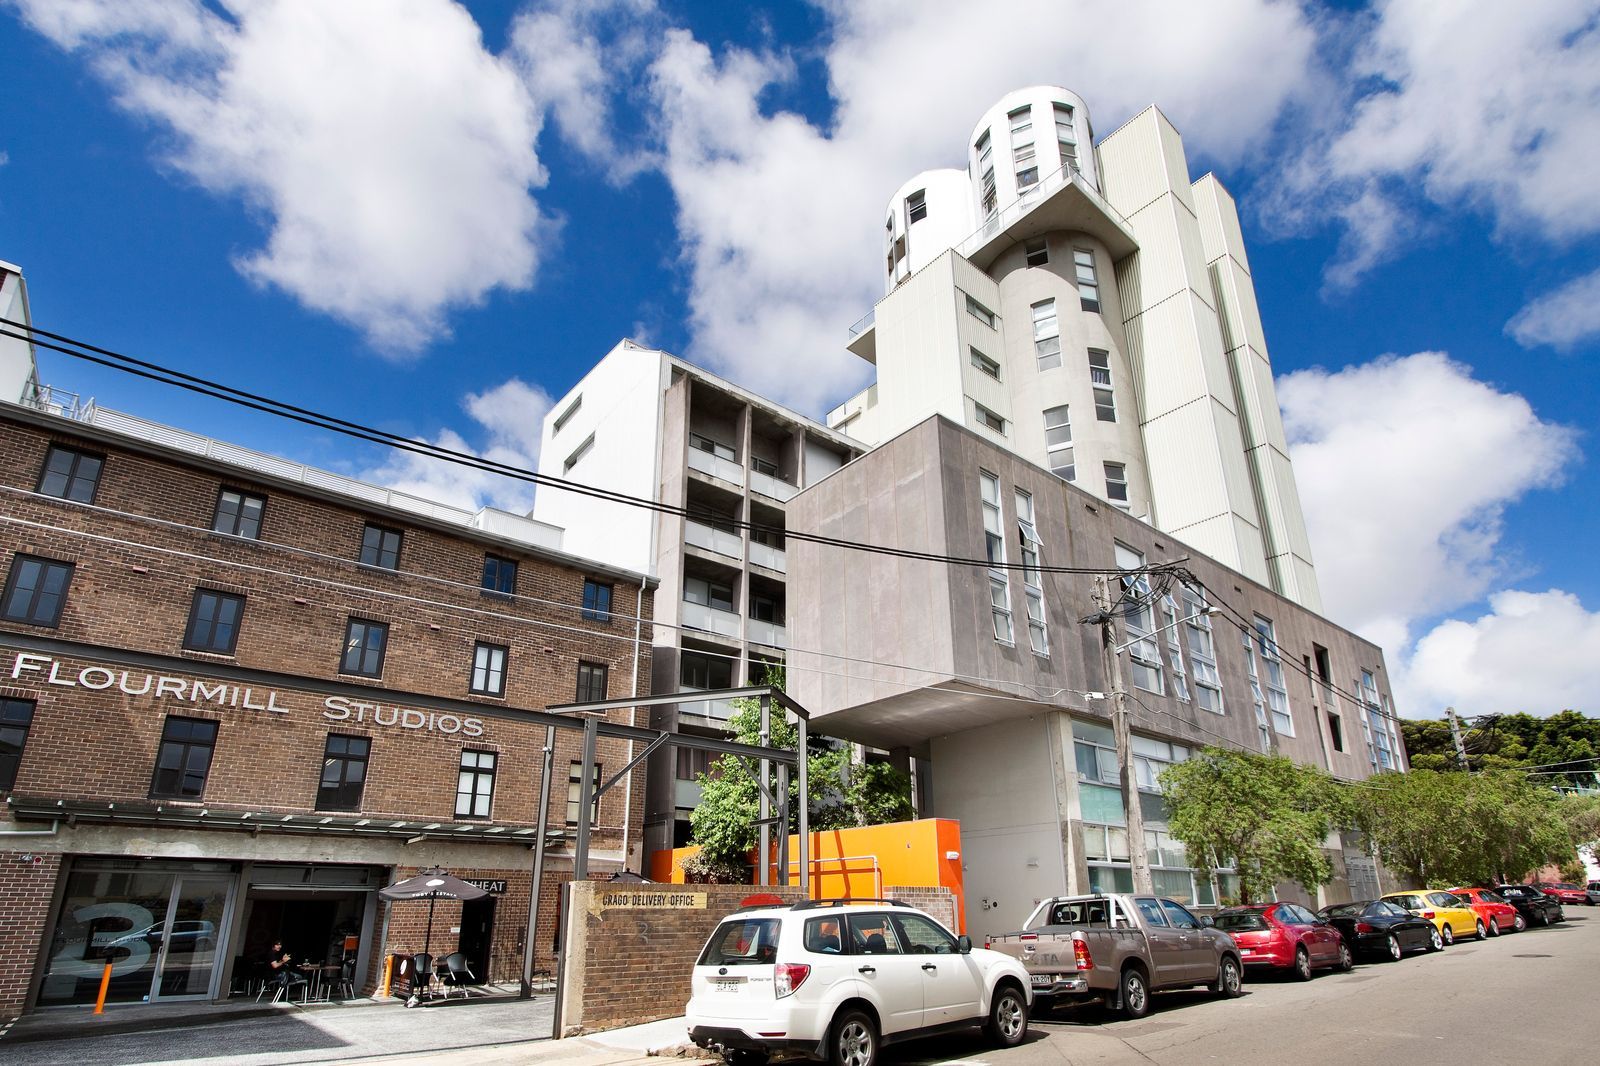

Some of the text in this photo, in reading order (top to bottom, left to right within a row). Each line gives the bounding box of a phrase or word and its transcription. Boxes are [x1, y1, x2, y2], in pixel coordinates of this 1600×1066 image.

[11, 653, 484, 737] FLOURMILL STUDIOS
[632, 895, 666, 906] DELIVERY
[670, 895, 695, 906] OFFICE
[60, 902, 154, 979] 3
